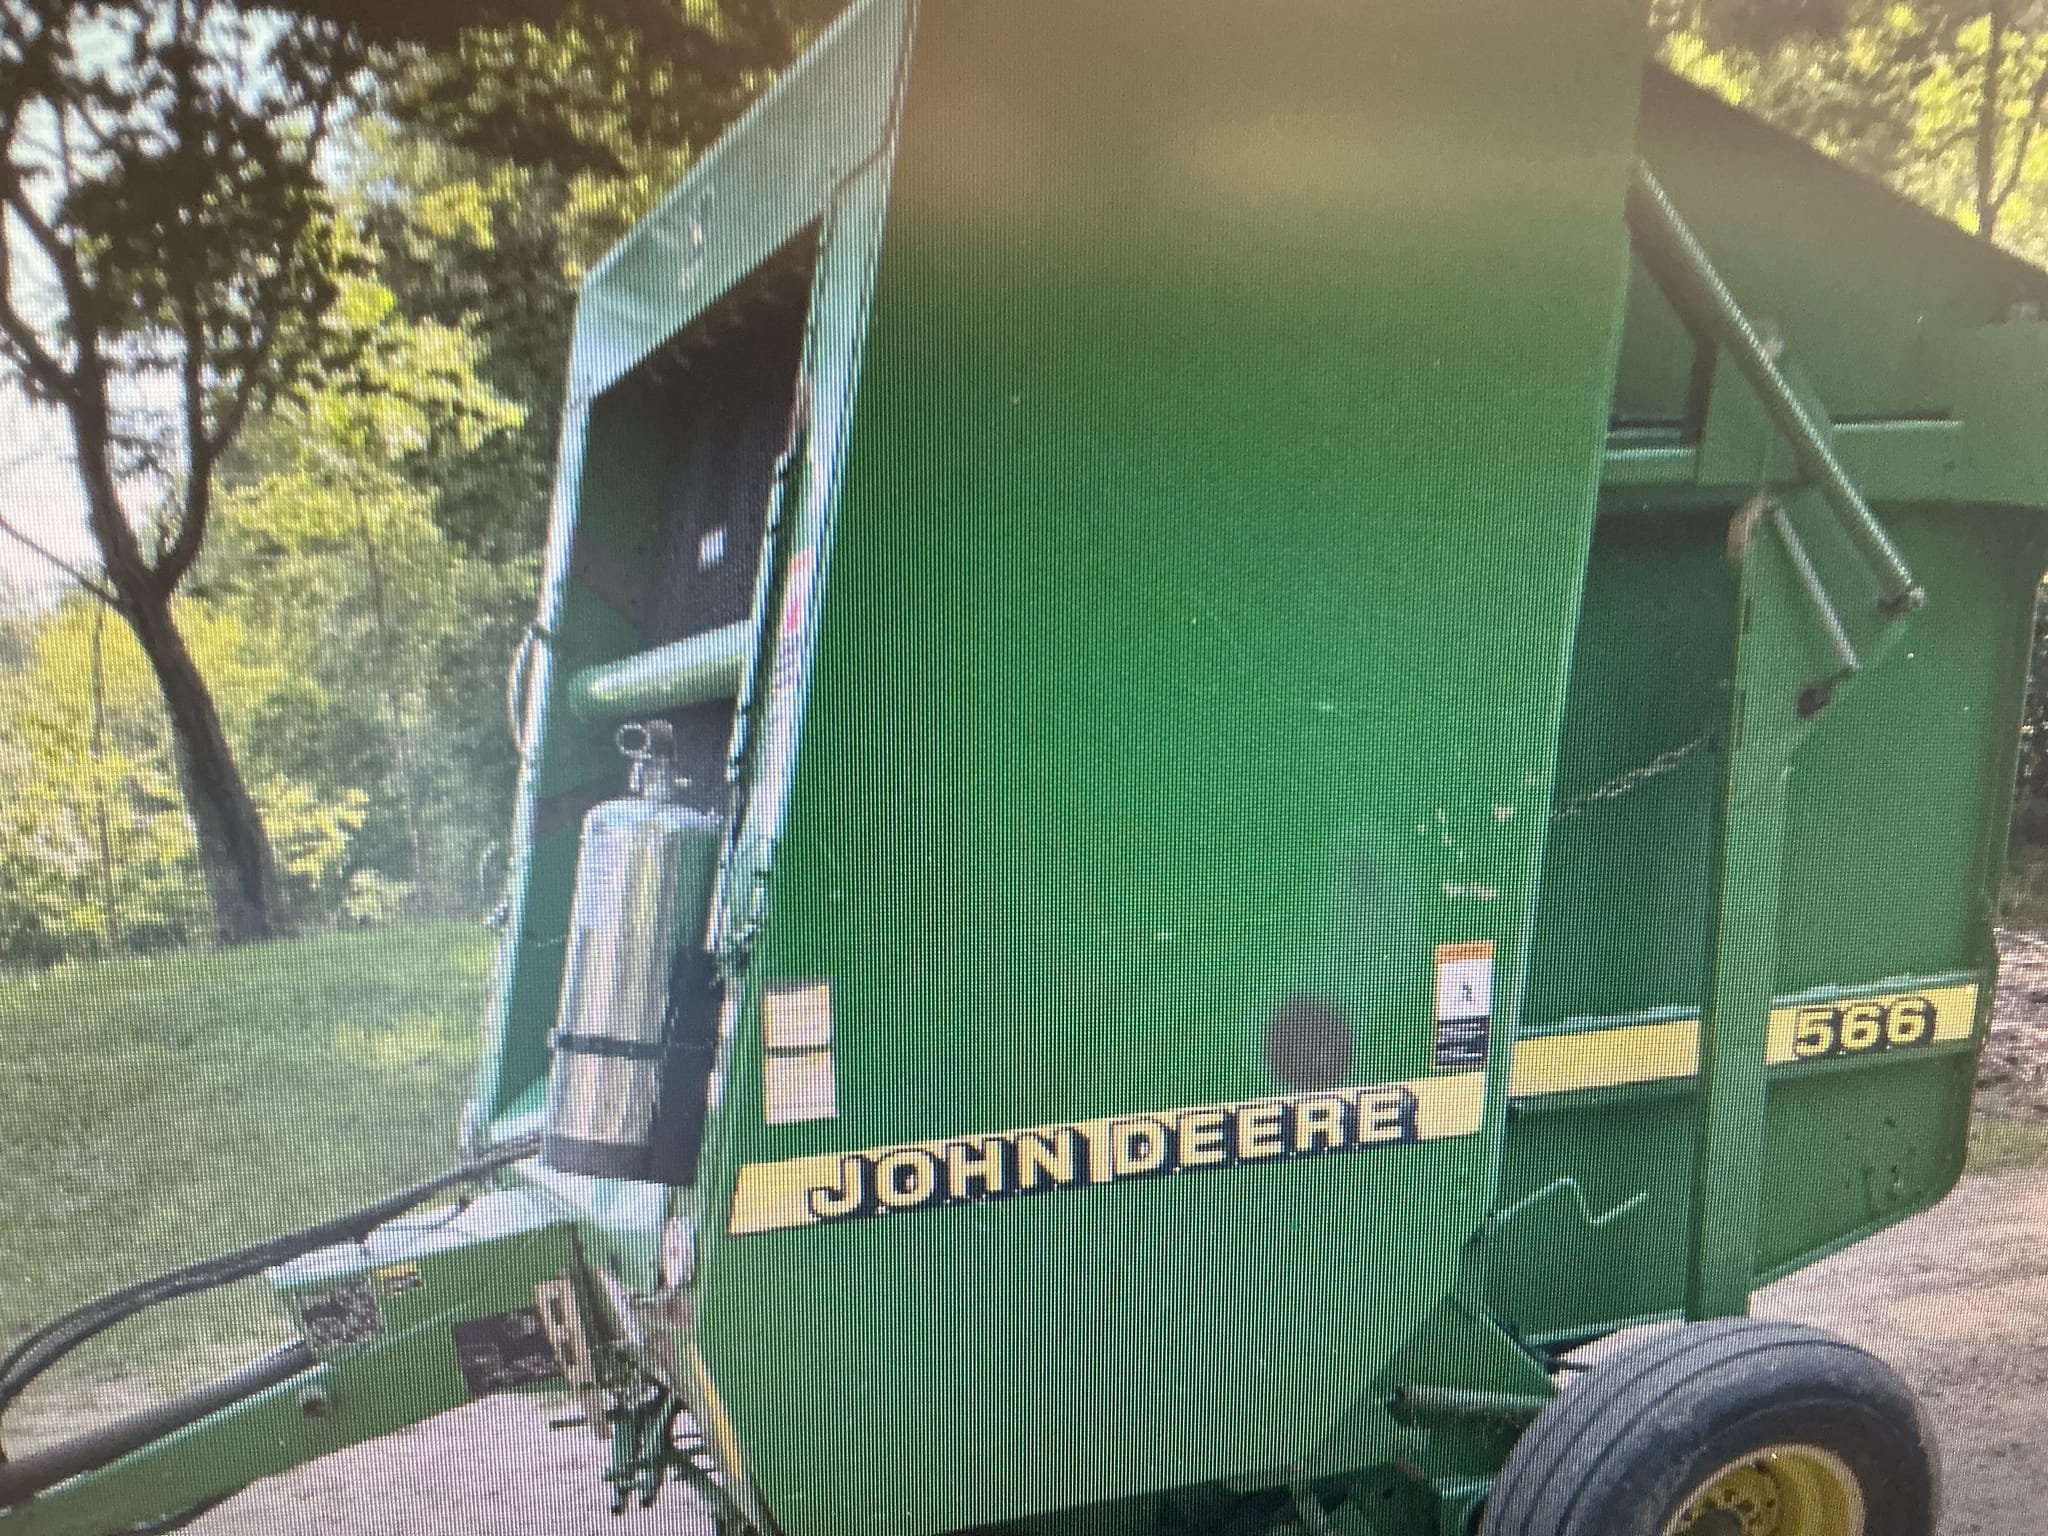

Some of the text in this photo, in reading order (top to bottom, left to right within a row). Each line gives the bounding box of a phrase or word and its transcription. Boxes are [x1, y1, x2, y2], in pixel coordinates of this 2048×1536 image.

[1795, 998, 1934, 1058] 566
[808, 1087, 1417, 1219] JOHN DEERE
